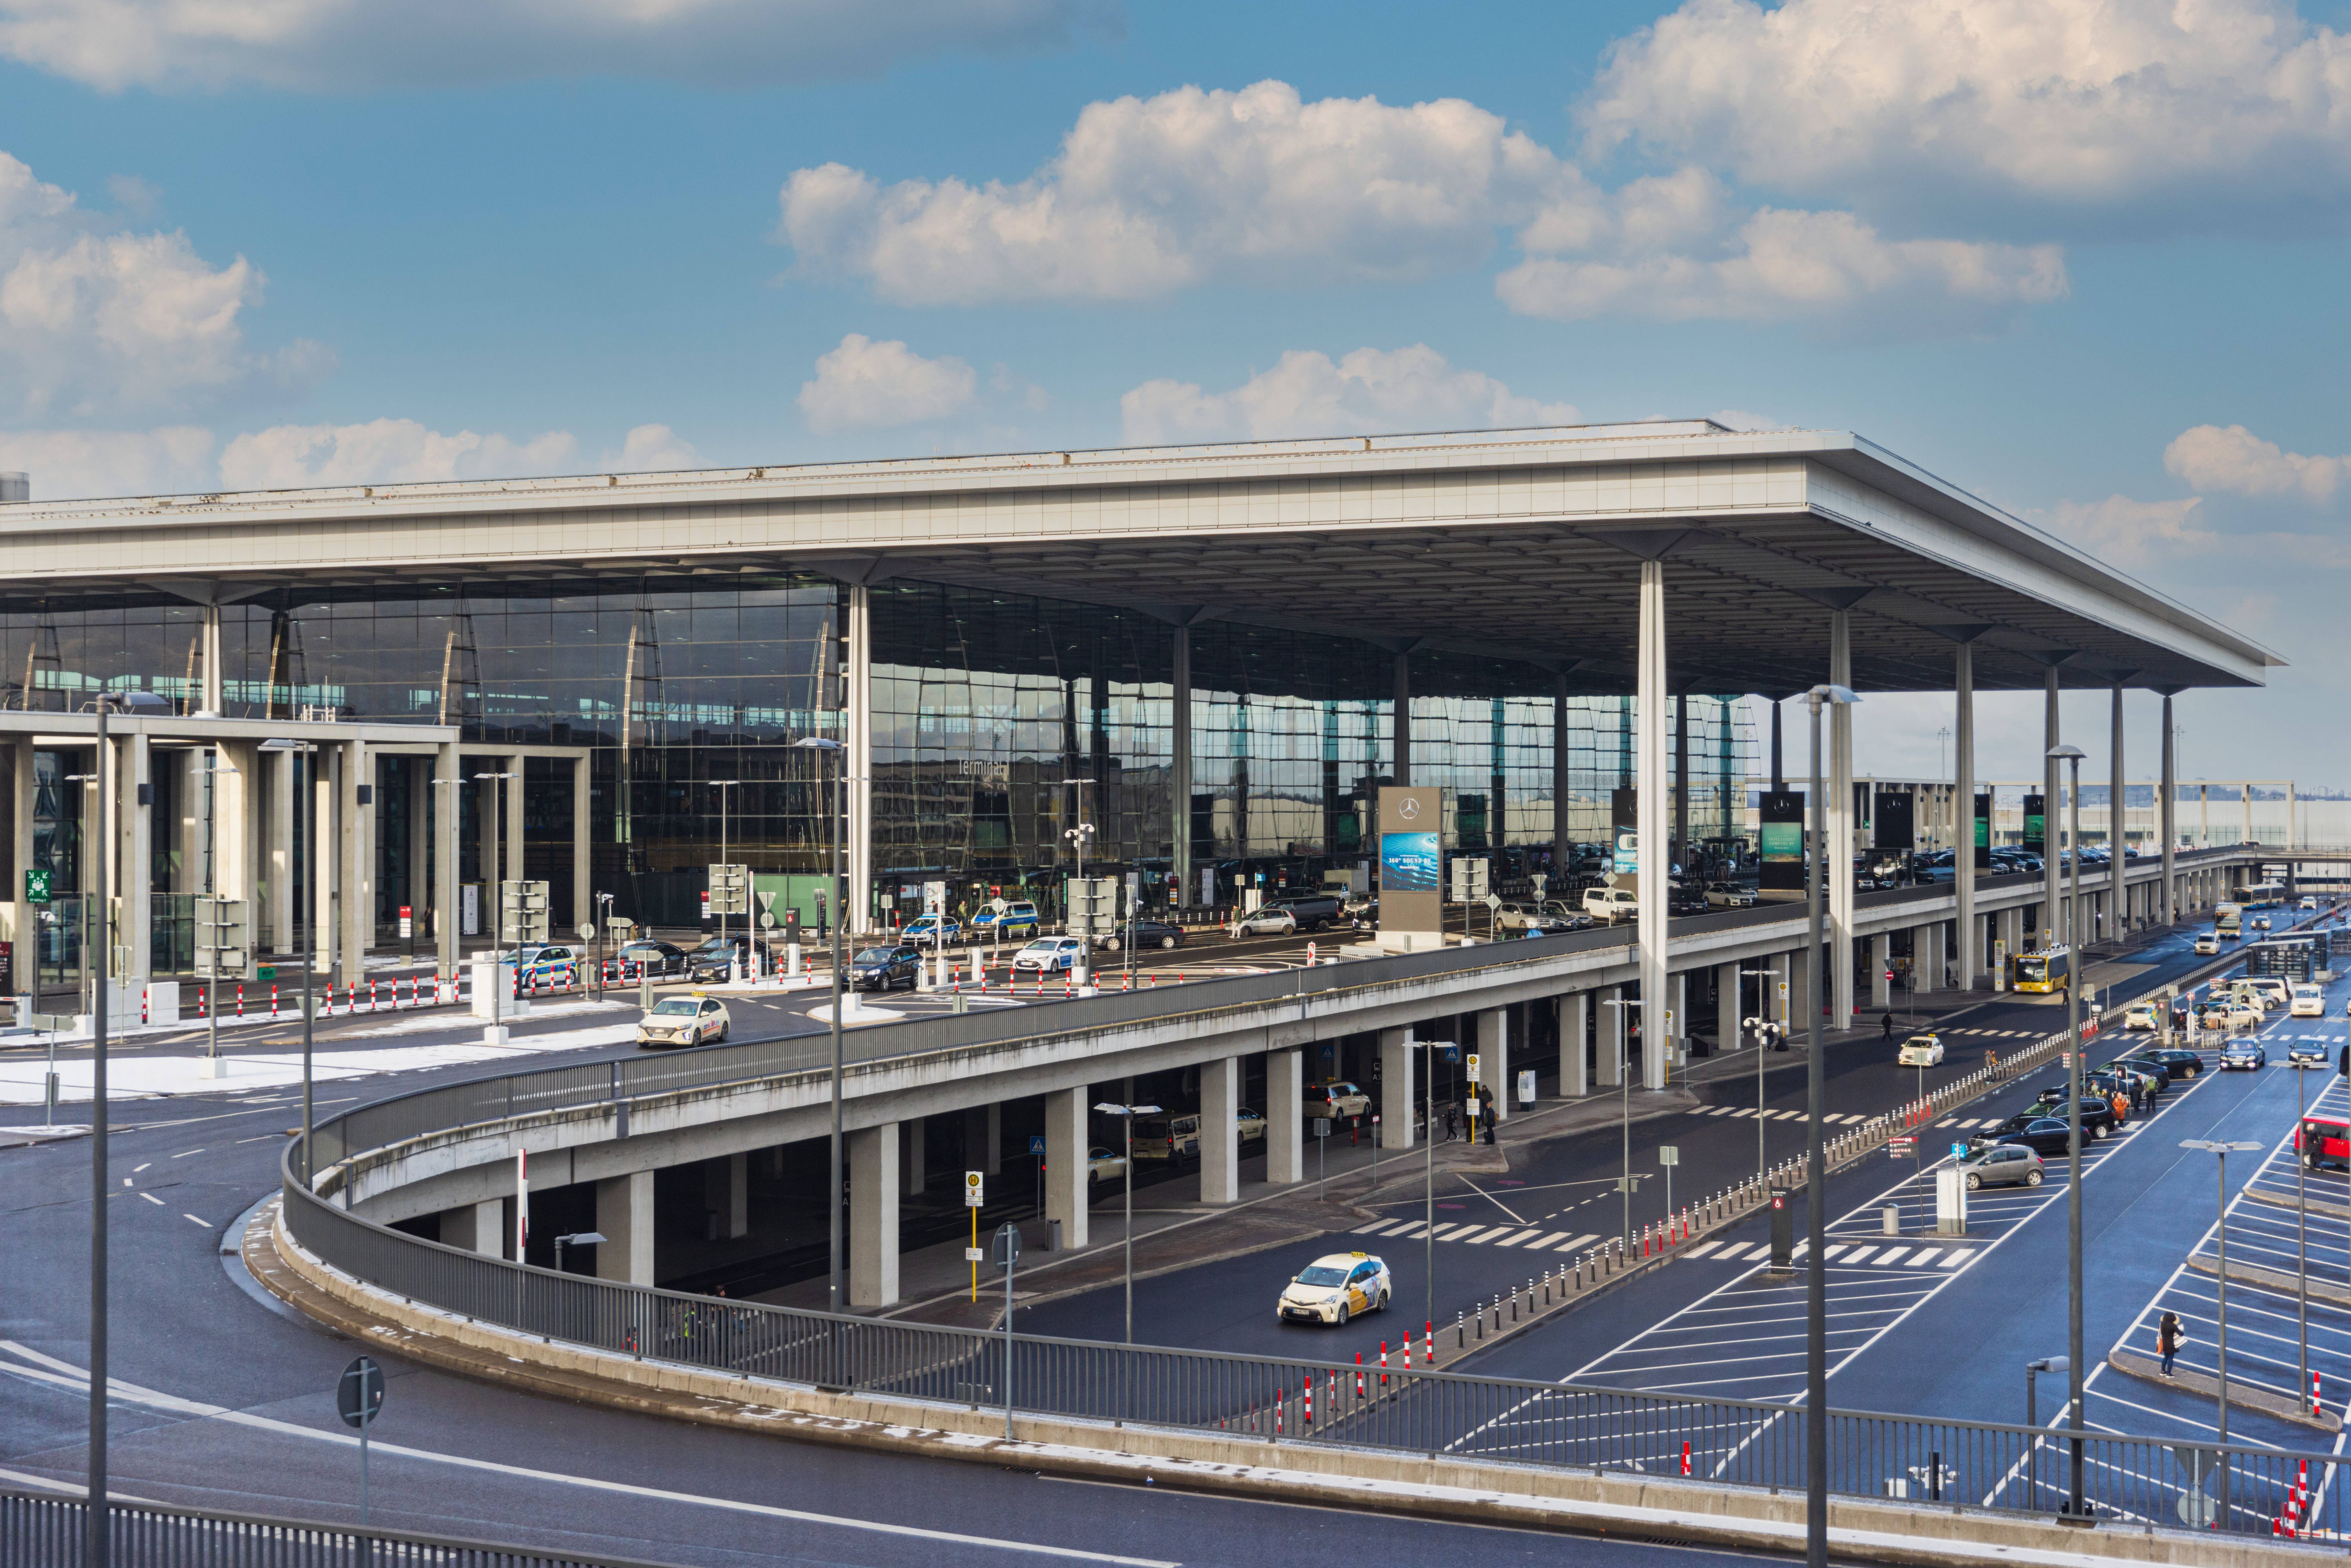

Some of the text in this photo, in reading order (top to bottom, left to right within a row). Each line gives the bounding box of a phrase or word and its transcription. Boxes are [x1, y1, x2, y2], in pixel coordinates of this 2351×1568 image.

[957, 757, 1004, 776] Terminal
[1569, 774, 1583, 784] BERLIN
[1585, 775, 1614, 786] BRANDENBURG
